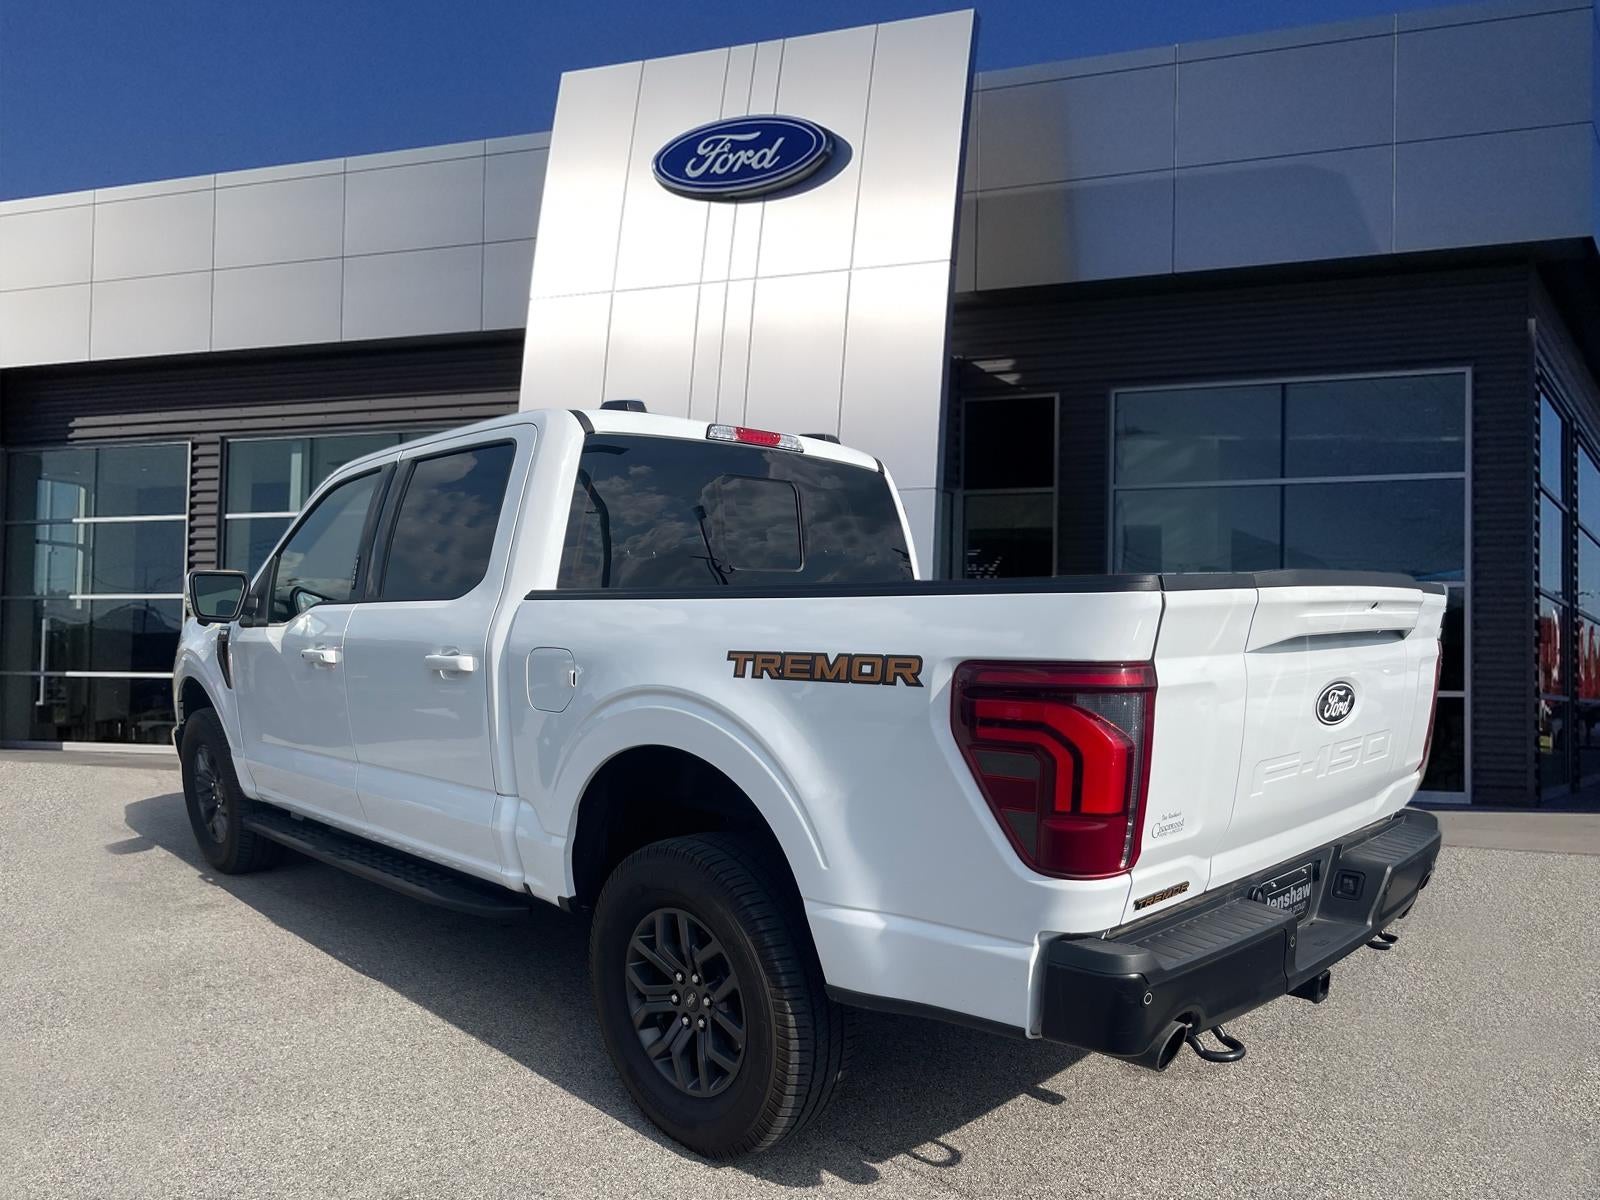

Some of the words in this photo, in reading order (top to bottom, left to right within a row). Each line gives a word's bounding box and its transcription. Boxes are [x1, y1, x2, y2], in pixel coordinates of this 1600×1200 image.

[685, 131, 785, 178] Ford
[727, 650, 924, 687] TREMOR
[1324, 689, 1351, 718] Ford
[1250, 730, 1392, 797] F-150
[1133, 880, 1190, 911] TREMOR
